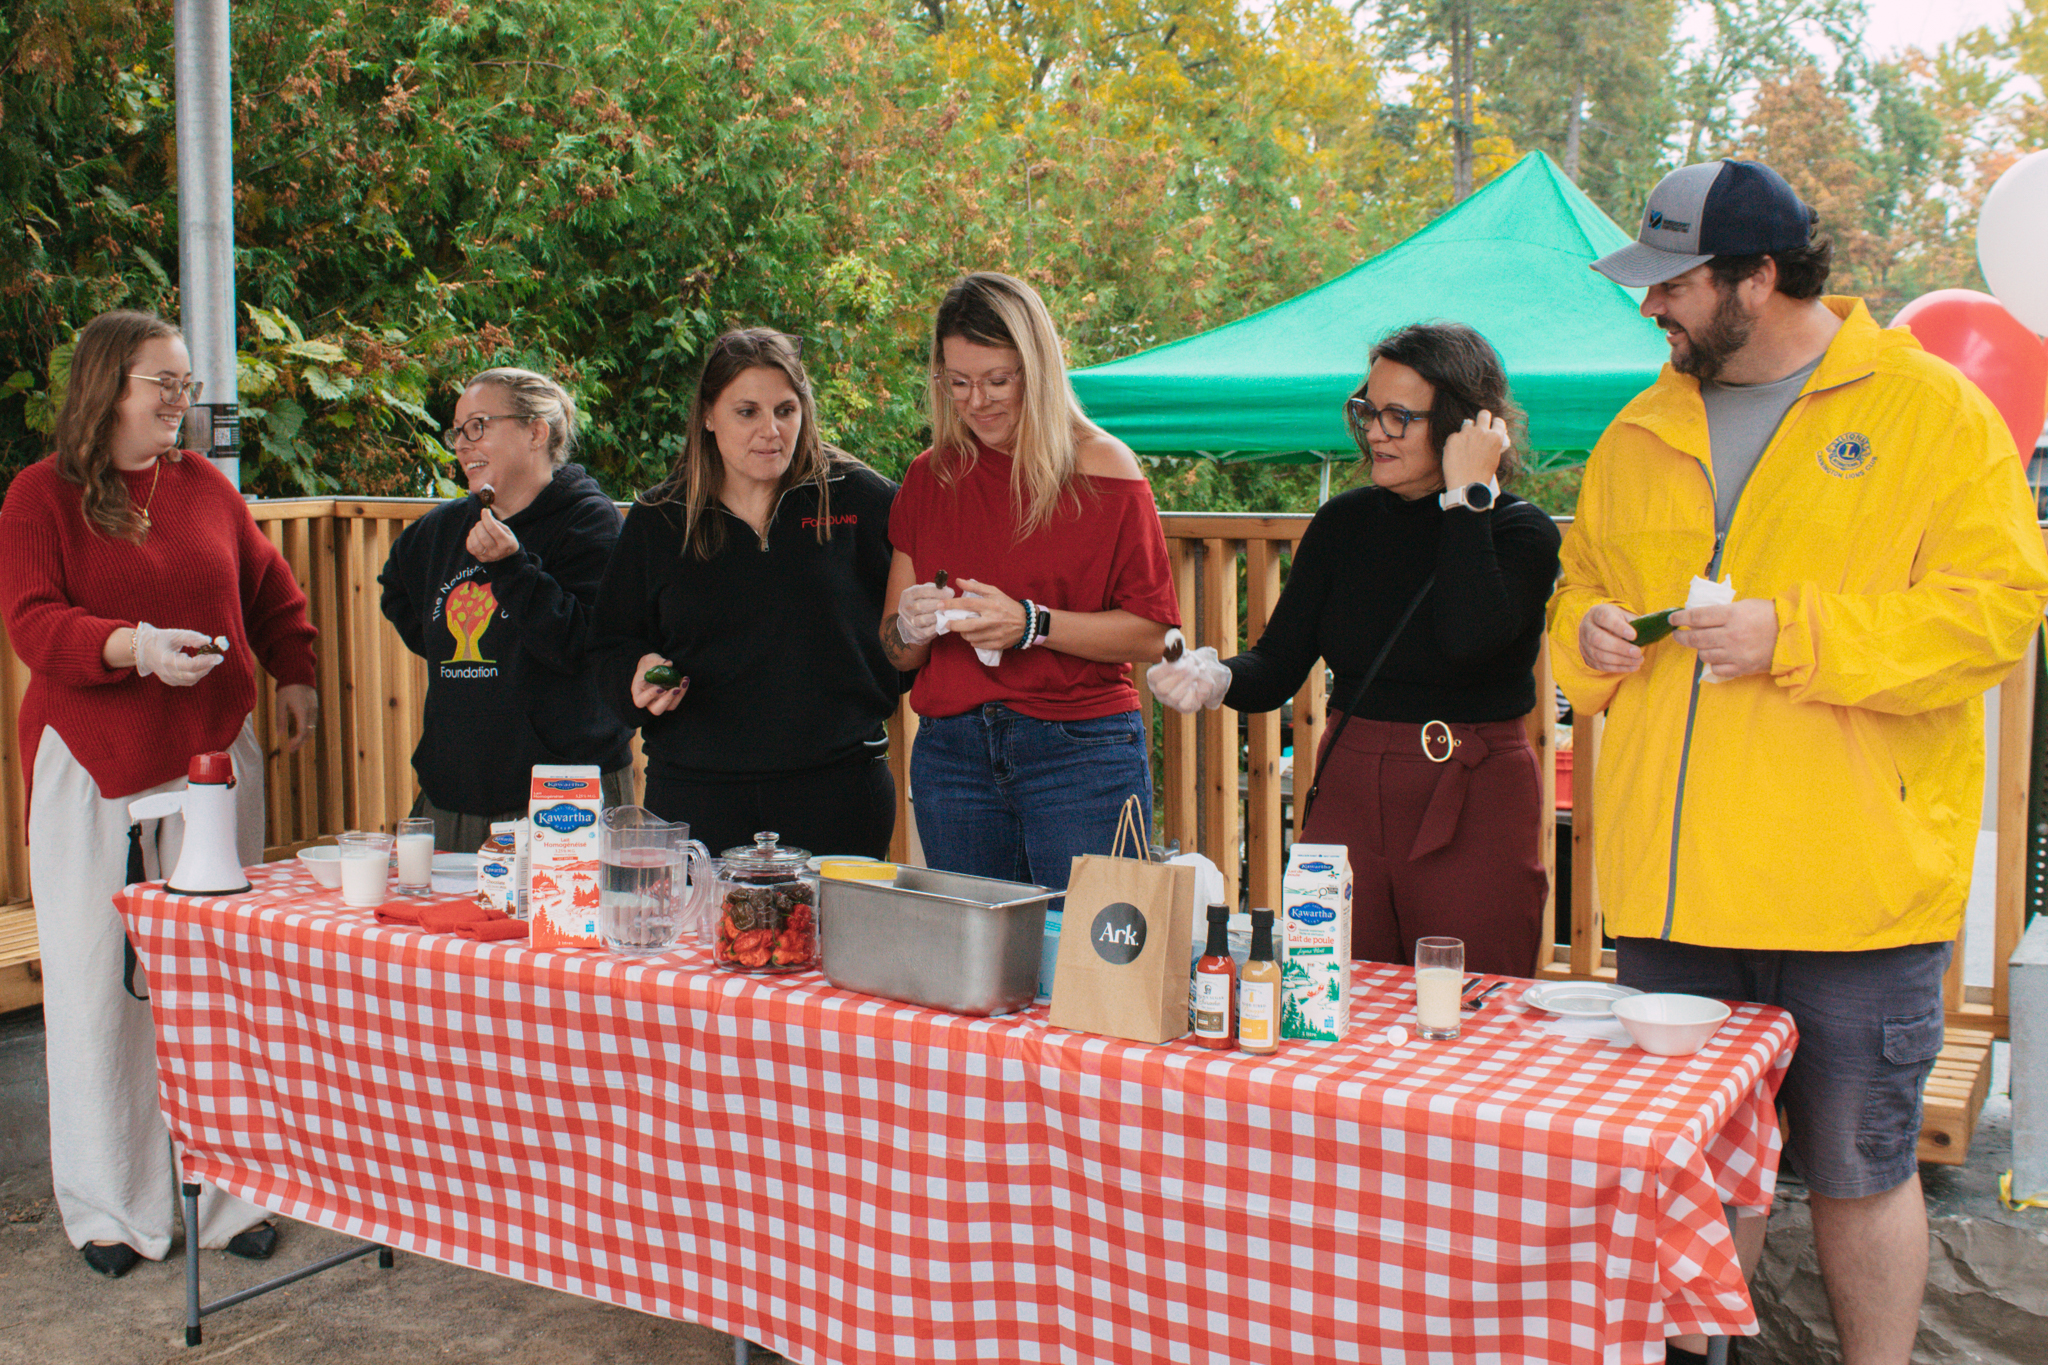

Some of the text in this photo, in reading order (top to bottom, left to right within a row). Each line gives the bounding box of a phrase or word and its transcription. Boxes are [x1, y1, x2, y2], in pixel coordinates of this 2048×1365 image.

[1842, 443, 1857, 459] L
[1845, 469, 1865, 480] LIONS
[1864, 455, 1878, 471] CLUB
[801, 514, 858, 529] FOODLAND
[432, 597, 443, 622] The
[440, 666, 498, 679] Foundation
[538, 812, 592, 824] Kawartha
[543, 841, 587, 849] Homogénéisé
[1291, 908, 1333, 918] Kawartha
[1099, 921, 1139, 946] Ark.
[1288, 933, 1303, 943] Lait
[1303, 935, 1312, 943] de
[1312, 936, 1335, 945] poule
